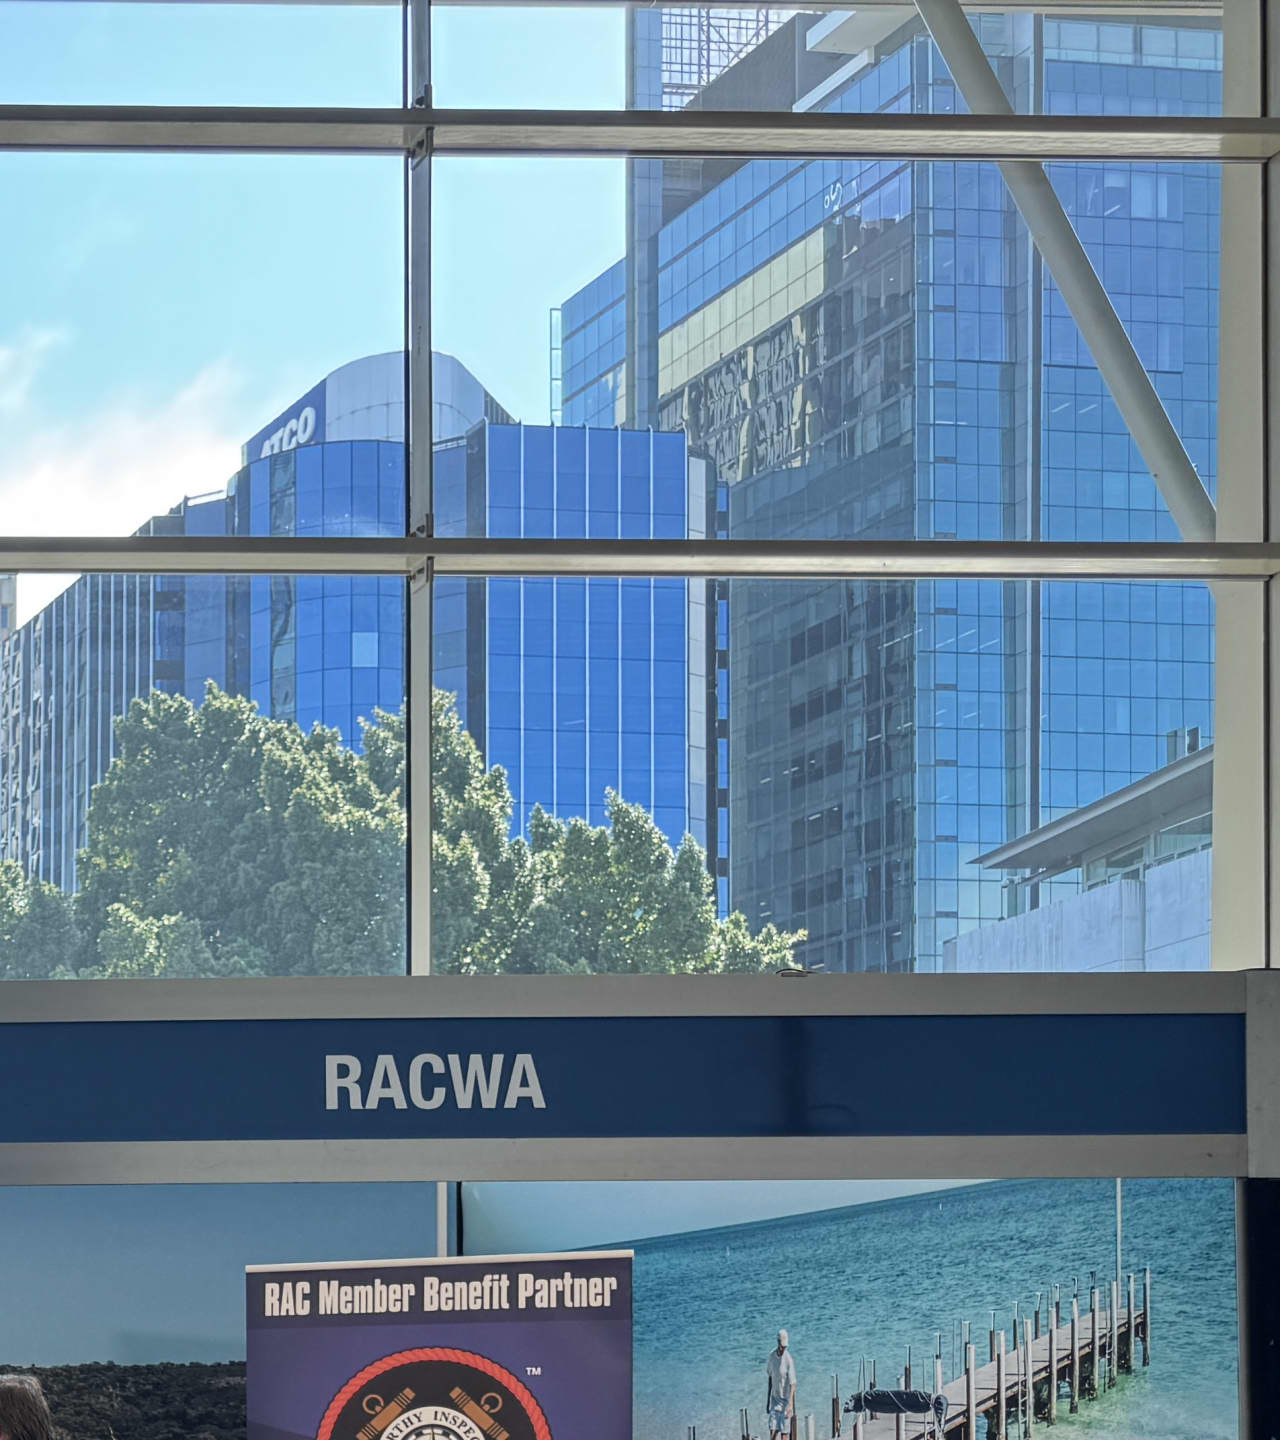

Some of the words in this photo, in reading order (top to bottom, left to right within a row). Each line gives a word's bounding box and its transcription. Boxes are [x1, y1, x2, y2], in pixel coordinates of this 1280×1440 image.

[260, 406, 316, 458] ATCO
[324, 1053, 547, 1111] RACWA
[264, 1281, 310, 1317] RAC
[319, 1278, 416, 1315] Member
[423, 1274, 510, 1312] Benefit
[518, 1272, 617, 1309] Partner
[526, 1367, 541, 1376] TM
